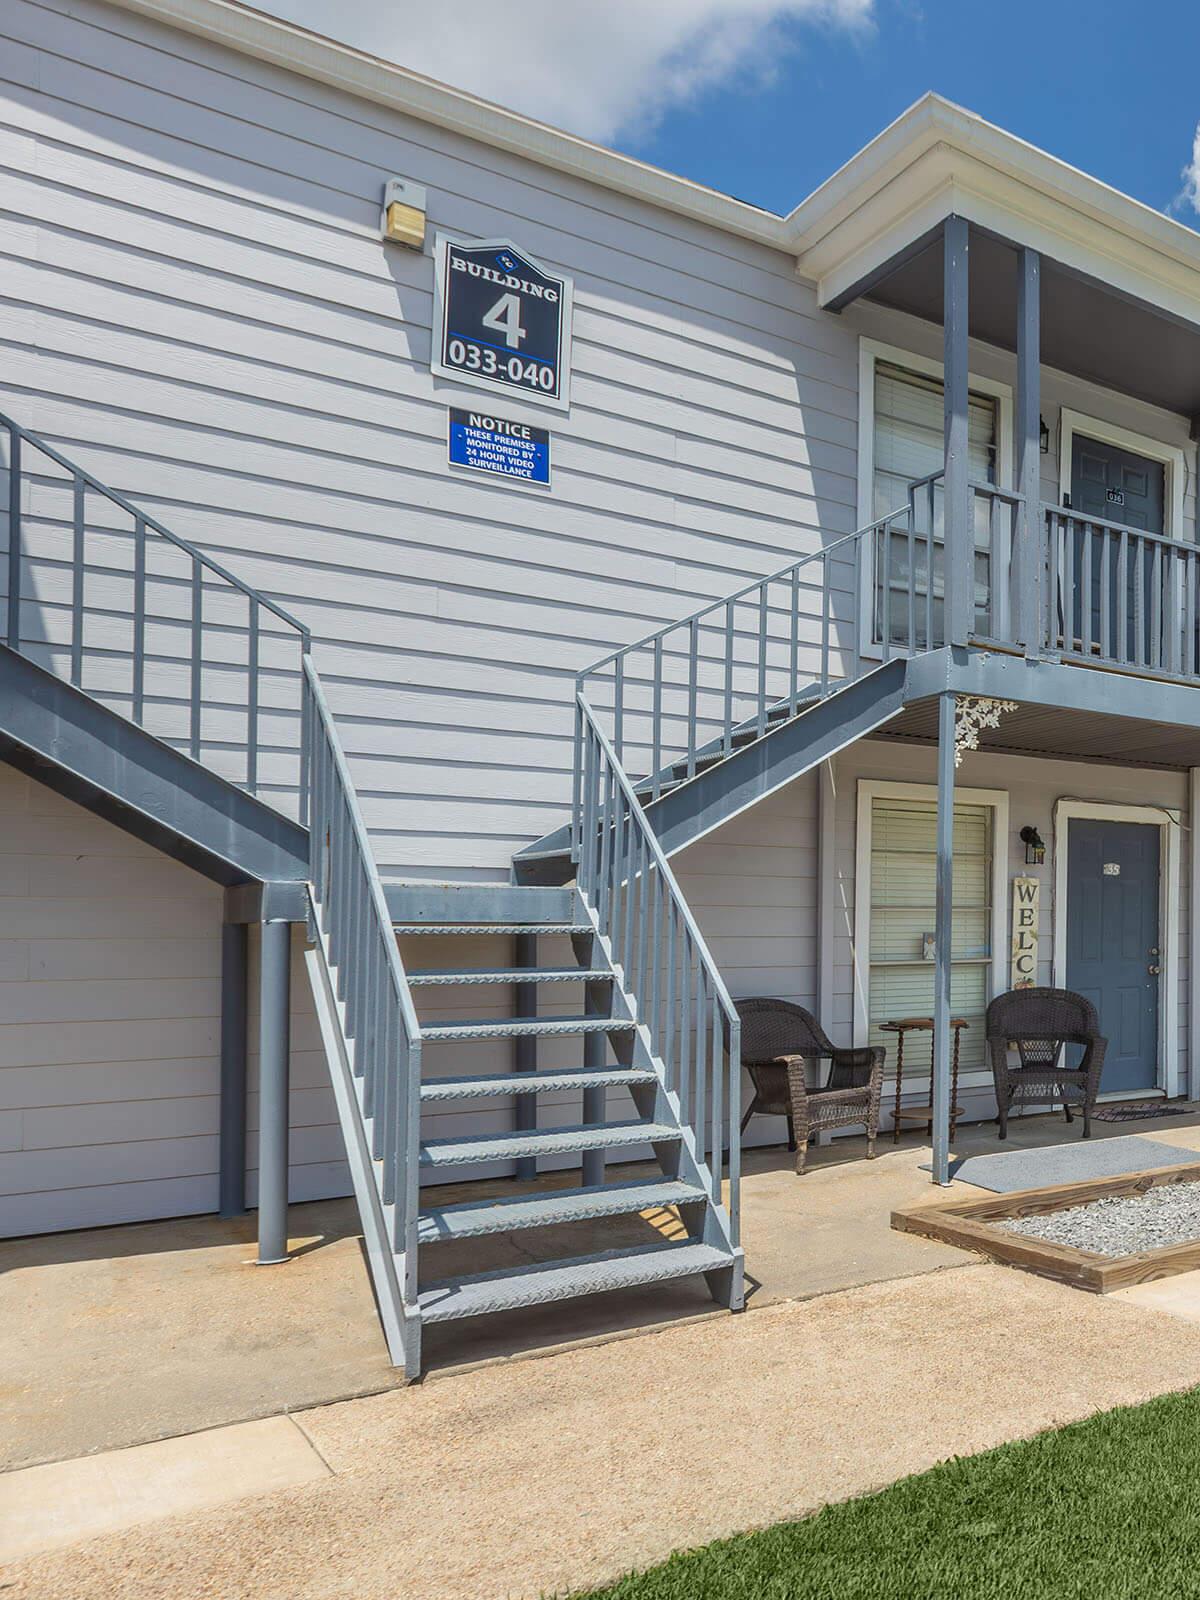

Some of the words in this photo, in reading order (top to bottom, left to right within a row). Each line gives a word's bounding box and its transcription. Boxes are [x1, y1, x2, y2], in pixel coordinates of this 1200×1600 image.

[451, 256, 559, 303] BUILDING
[482, 292, 527, 349] 4
[449, 340, 554, 390] 033-040
[464, 427, 492, 441] THESE
[494, 434, 536, 451] PREMISES
[469, 413, 531, 440] NOTICE
[466, 437, 520, 456] MONITORED
[521, 450, 534, 460] BY
[466, 447, 477, 456] 24
[480, 451, 506, 463] HOUR
[507, 457, 535, 469] VIDEO
[468, 457, 532, 478] SURVEILLANCE
